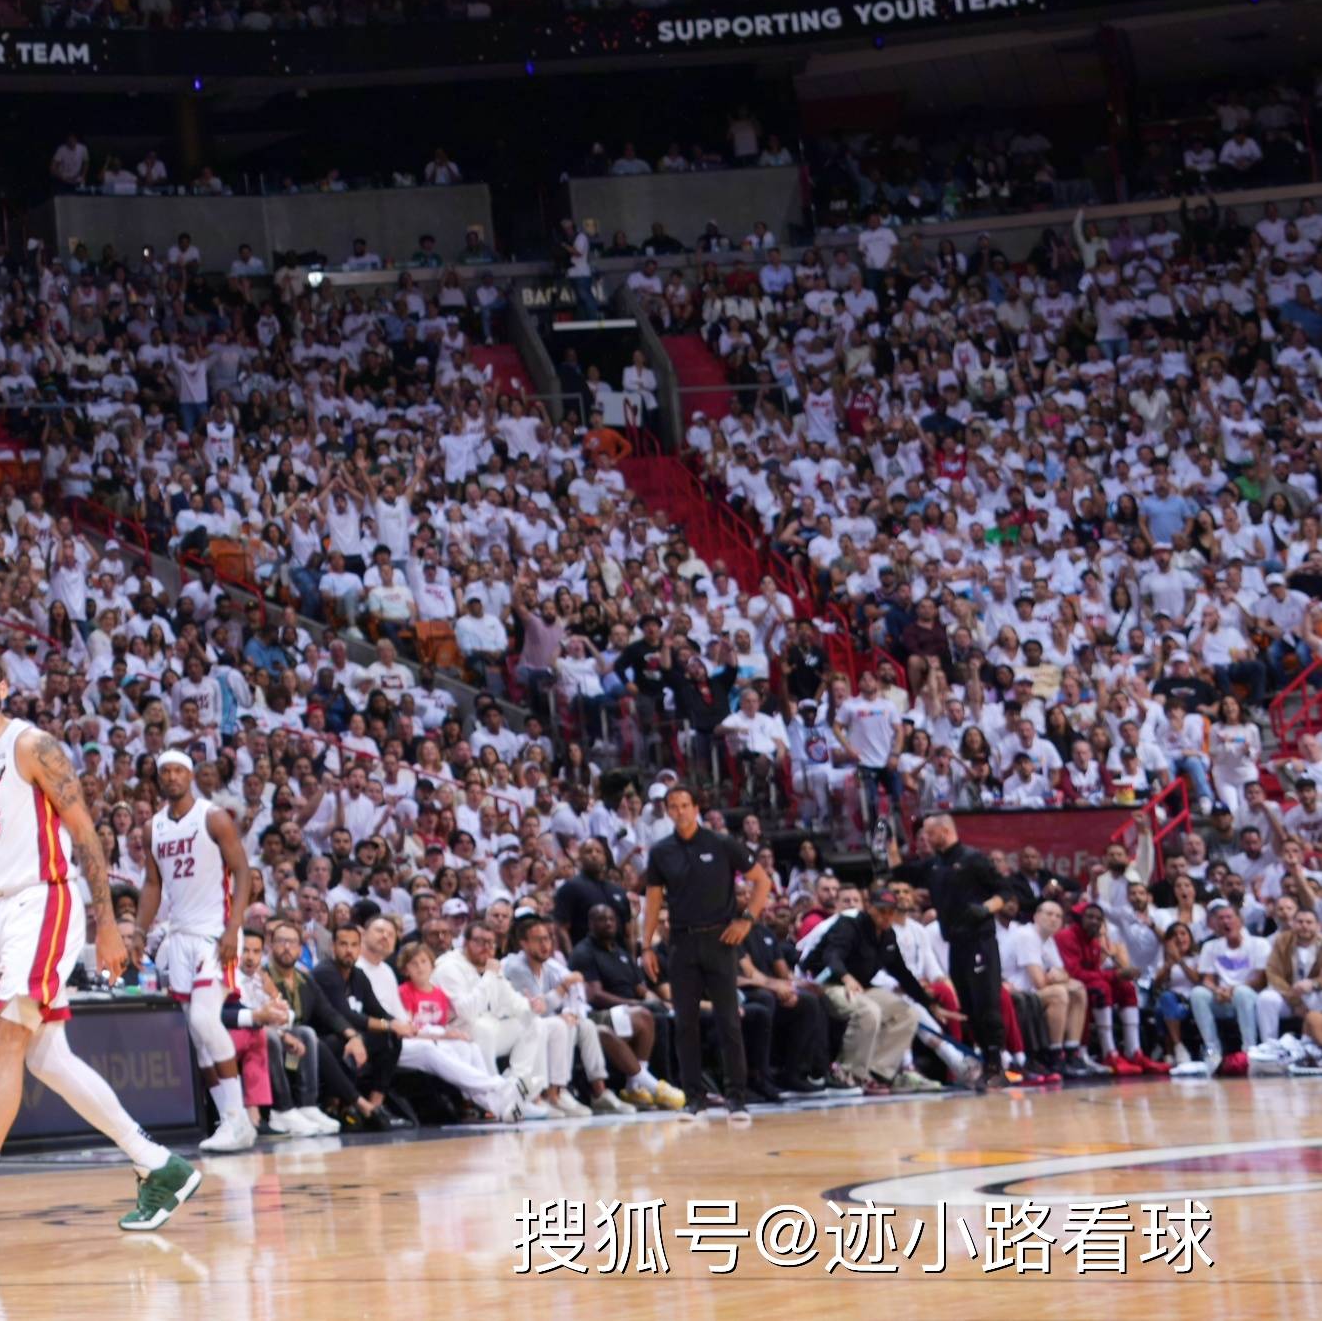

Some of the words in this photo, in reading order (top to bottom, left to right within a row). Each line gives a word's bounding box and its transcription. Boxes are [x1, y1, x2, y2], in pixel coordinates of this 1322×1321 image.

[657, 4, 843, 44] SUPPORTING
[16, 42, 89, 65] TEAM
[157, 830, 198, 859] HEAT
[173, 857, 195, 880] 22
